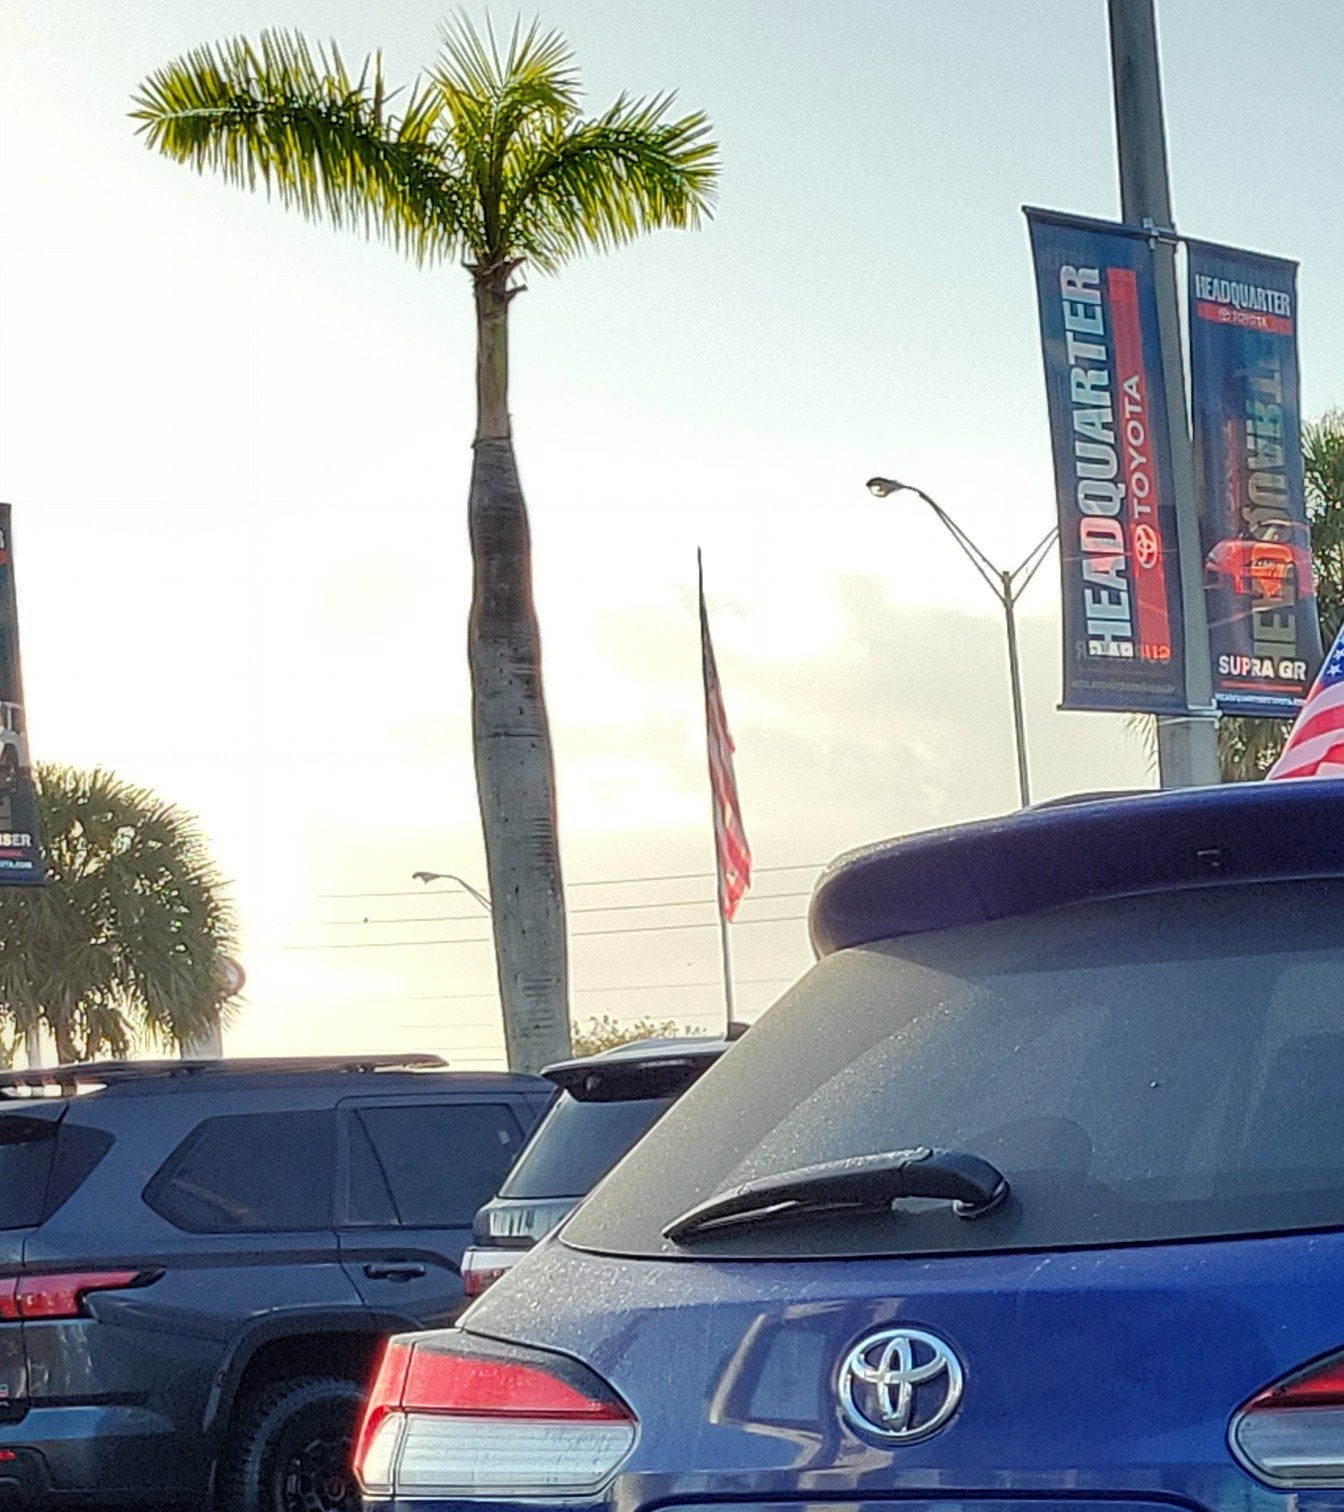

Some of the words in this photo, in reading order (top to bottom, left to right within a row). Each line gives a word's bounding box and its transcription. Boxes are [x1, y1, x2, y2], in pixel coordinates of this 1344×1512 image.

[1195, 274, 1291, 317] HEADQUARTER
[1060, 265, 1134, 658] HEADQUARTER
[1123, 374, 1152, 519] TOYOTA
[1218, 655, 1275, 678] SUPRA
[1278, 660, 1307, 680] GR
